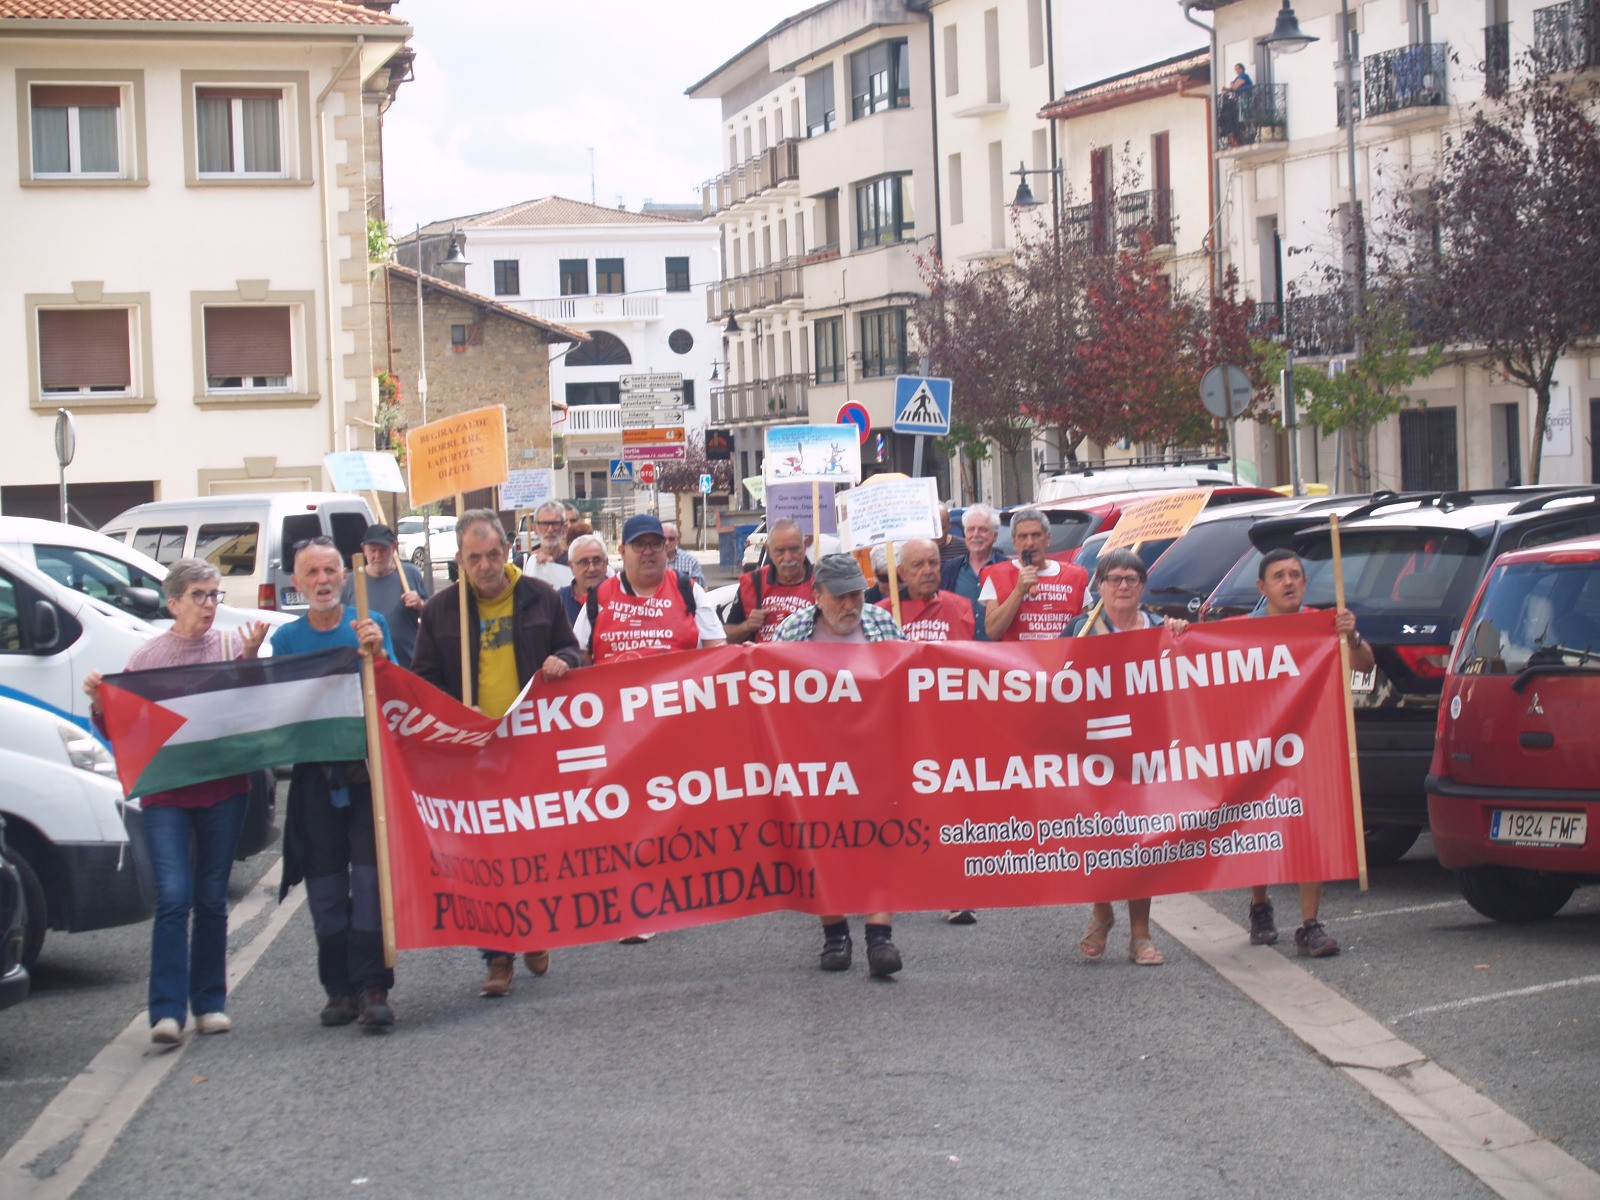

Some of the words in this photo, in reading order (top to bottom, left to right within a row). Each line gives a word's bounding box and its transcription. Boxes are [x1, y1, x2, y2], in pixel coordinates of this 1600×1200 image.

[420, 427, 454, 444] BEGIRA
[438, 462, 473, 480] DIZUTE
[1173, 493, 1206, 502] QUIEN
[1118, 520, 1179, 538] PENSIONES
[1122, 526, 1184, 544] DEFIENDEN
[1020, 612, 1072, 622] GUTXIENEK
[600, 629, 674, 642] GUTXIENEKO
[610, 639, 662, 651] SOLDATA
[908, 660, 1112, 704] PENSIÓN
[1125, 643, 1301, 696] MÍNIMA
[619, 668, 863, 722] PENTSIOA
[911, 753, 1115, 794] SALARIO
[1131, 732, 1306, 785] MÍNIMO
[646, 761, 860, 812] SOLDATA
[939, 815, 1033, 845] sakanako
[1036, 810, 1177, 845] pentsiodunen
[1179, 794, 1304, 831] mugimendua
[1508, 814, 1542, 838] 1924
[1549, 816, 1581, 840] FMF
[511, 854, 549, 885] DE
[556, 825, 717, 880] ATENCIÓN
[728, 821, 749, 851] Y
[757, 817, 931, 853] CUIDADOS;
[964, 849, 1081, 877] movimiento
[1083, 838, 1206, 876] pensionistas
[1208, 829, 1284, 858] sakana
[538, 896, 562, 933] Y
[571, 887, 622, 929] DE
